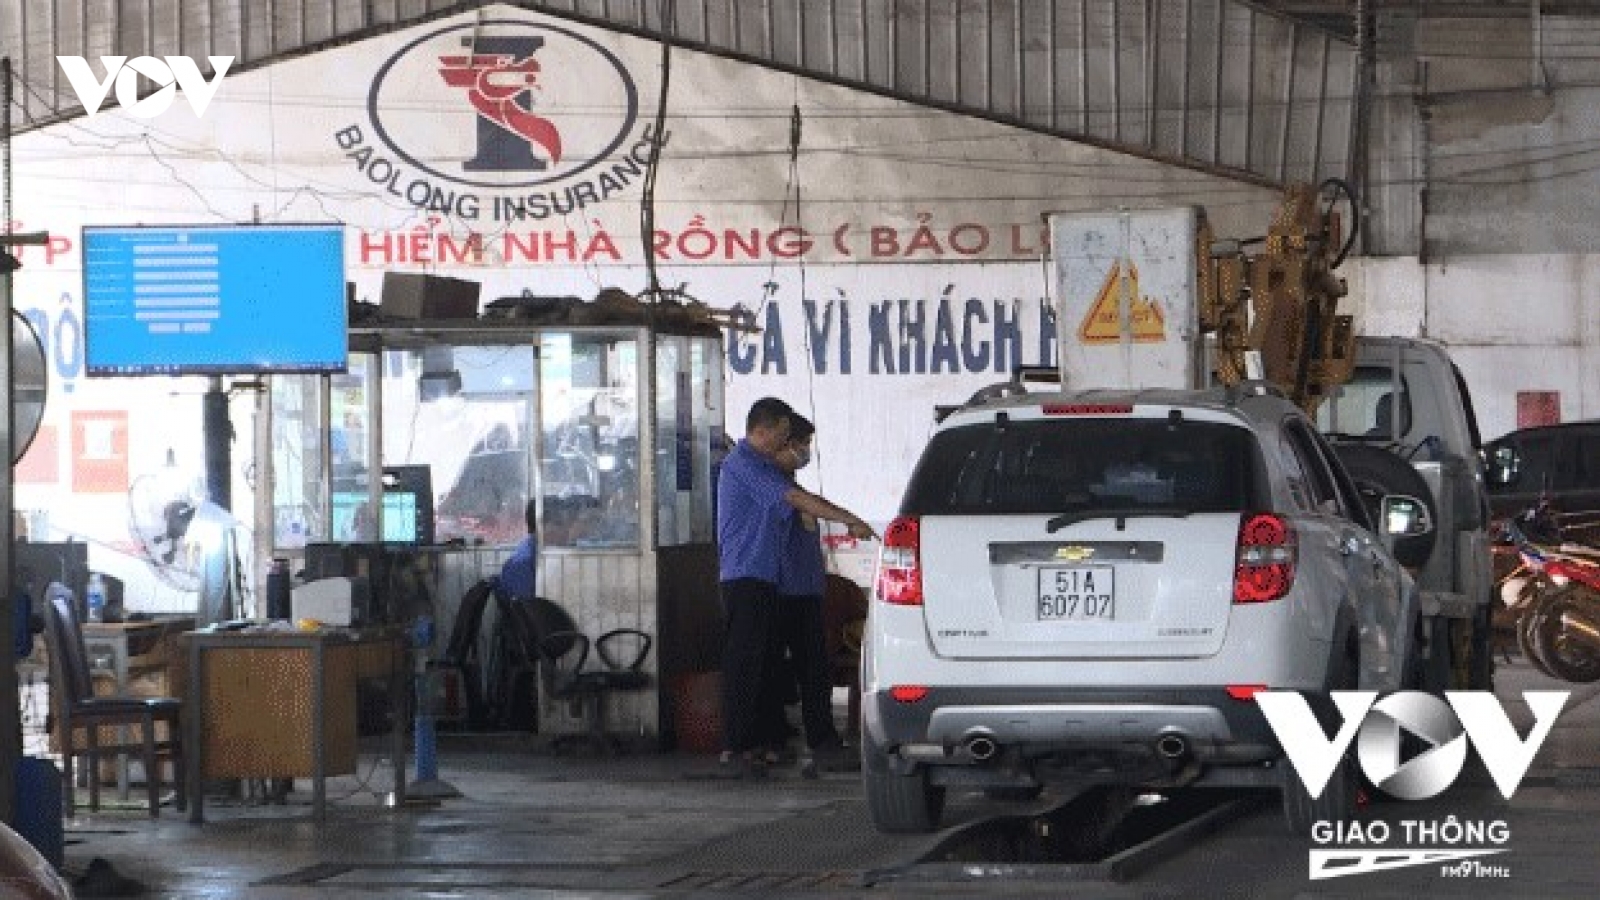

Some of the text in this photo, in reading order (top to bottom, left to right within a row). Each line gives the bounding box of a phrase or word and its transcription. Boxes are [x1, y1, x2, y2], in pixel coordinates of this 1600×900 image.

[335, 123, 672, 221] BAOLONG INSURANCE
[361, 216, 483, 263] HIỂM
[504, 217, 623, 263] NHÀ
[870, 212, 990, 257] BẢO
[1012, 224, 1051, 255] L
[802, 287, 851, 374] VÌ
[868, 284, 1023, 374] KHÁCH
